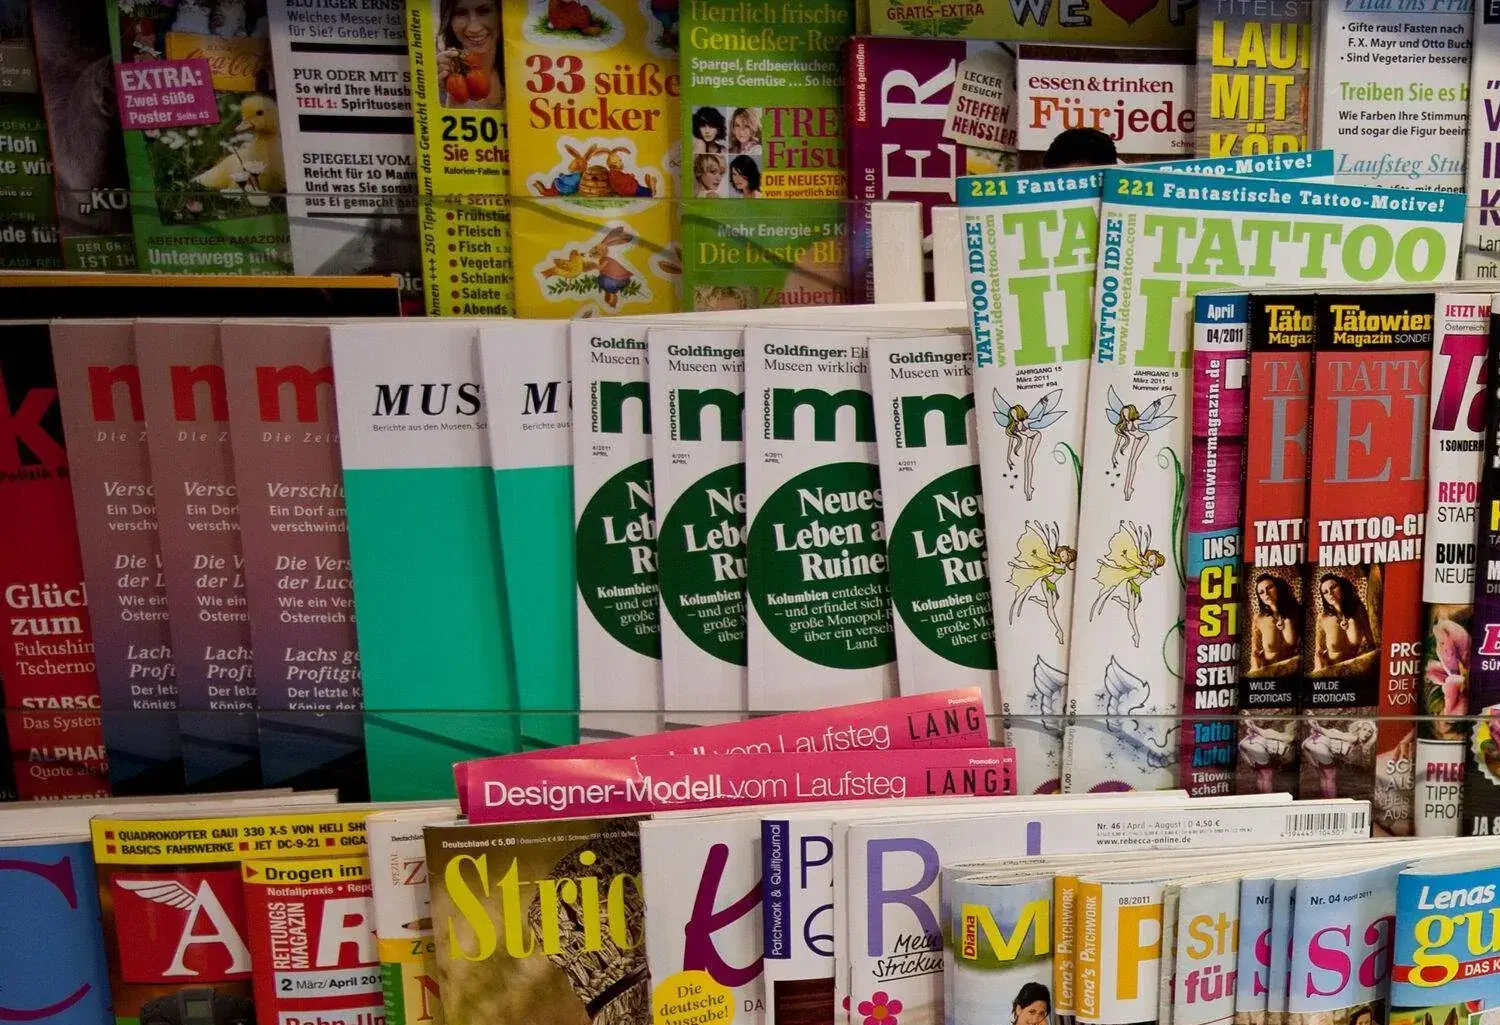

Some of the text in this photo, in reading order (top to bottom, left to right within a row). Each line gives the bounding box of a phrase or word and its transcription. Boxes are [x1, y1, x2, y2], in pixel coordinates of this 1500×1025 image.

[121, 66, 204, 90] EXTRA:
[526, 54, 681, 98] 33 süße
[1029, 74, 1174, 94] essen&trinken
[129, 111, 173, 124] Poster
[530, 97, 661, 132] Sticker
[1119, 179, 1445, 213] 221 Fantastische Tattoo-Motive!
[458, 225, 501, 238] Fleisch
[1144, 216, 1447, 280] TATTOO
[1098, 212, 1123, 365] TATTOO IDEE!
[1118, 213, 1136, 366] www.ideetattoo.com
[764, 344, 848, 360] Goldfinger:
[1202, 358, 1222, 525] taetowiermagazin.de
[774, 524, 855, 552] Leben
[1319, 540, 1422, 566] HAUTNAH!
[767, 585, 882, 606] Kolumbien entdeckt
[1312, 693, 1355, 703] EROTICATS
[484, 773, 906, 807] Designer-Modell vom Laufsteg
[119, 823, 344, 842] QUADROKOPTER GAUI 330 X-S VON HELI
[1097, 836, 1191, 845] www.rebecca-online.de
[122, 842, 233, 855] BASICS FAHRWERKE
[265, 863, 362, 883] Drogen im
[1418, 884, 1495, 910] Lenas
[660, 993, 725, 1015] deutsche
